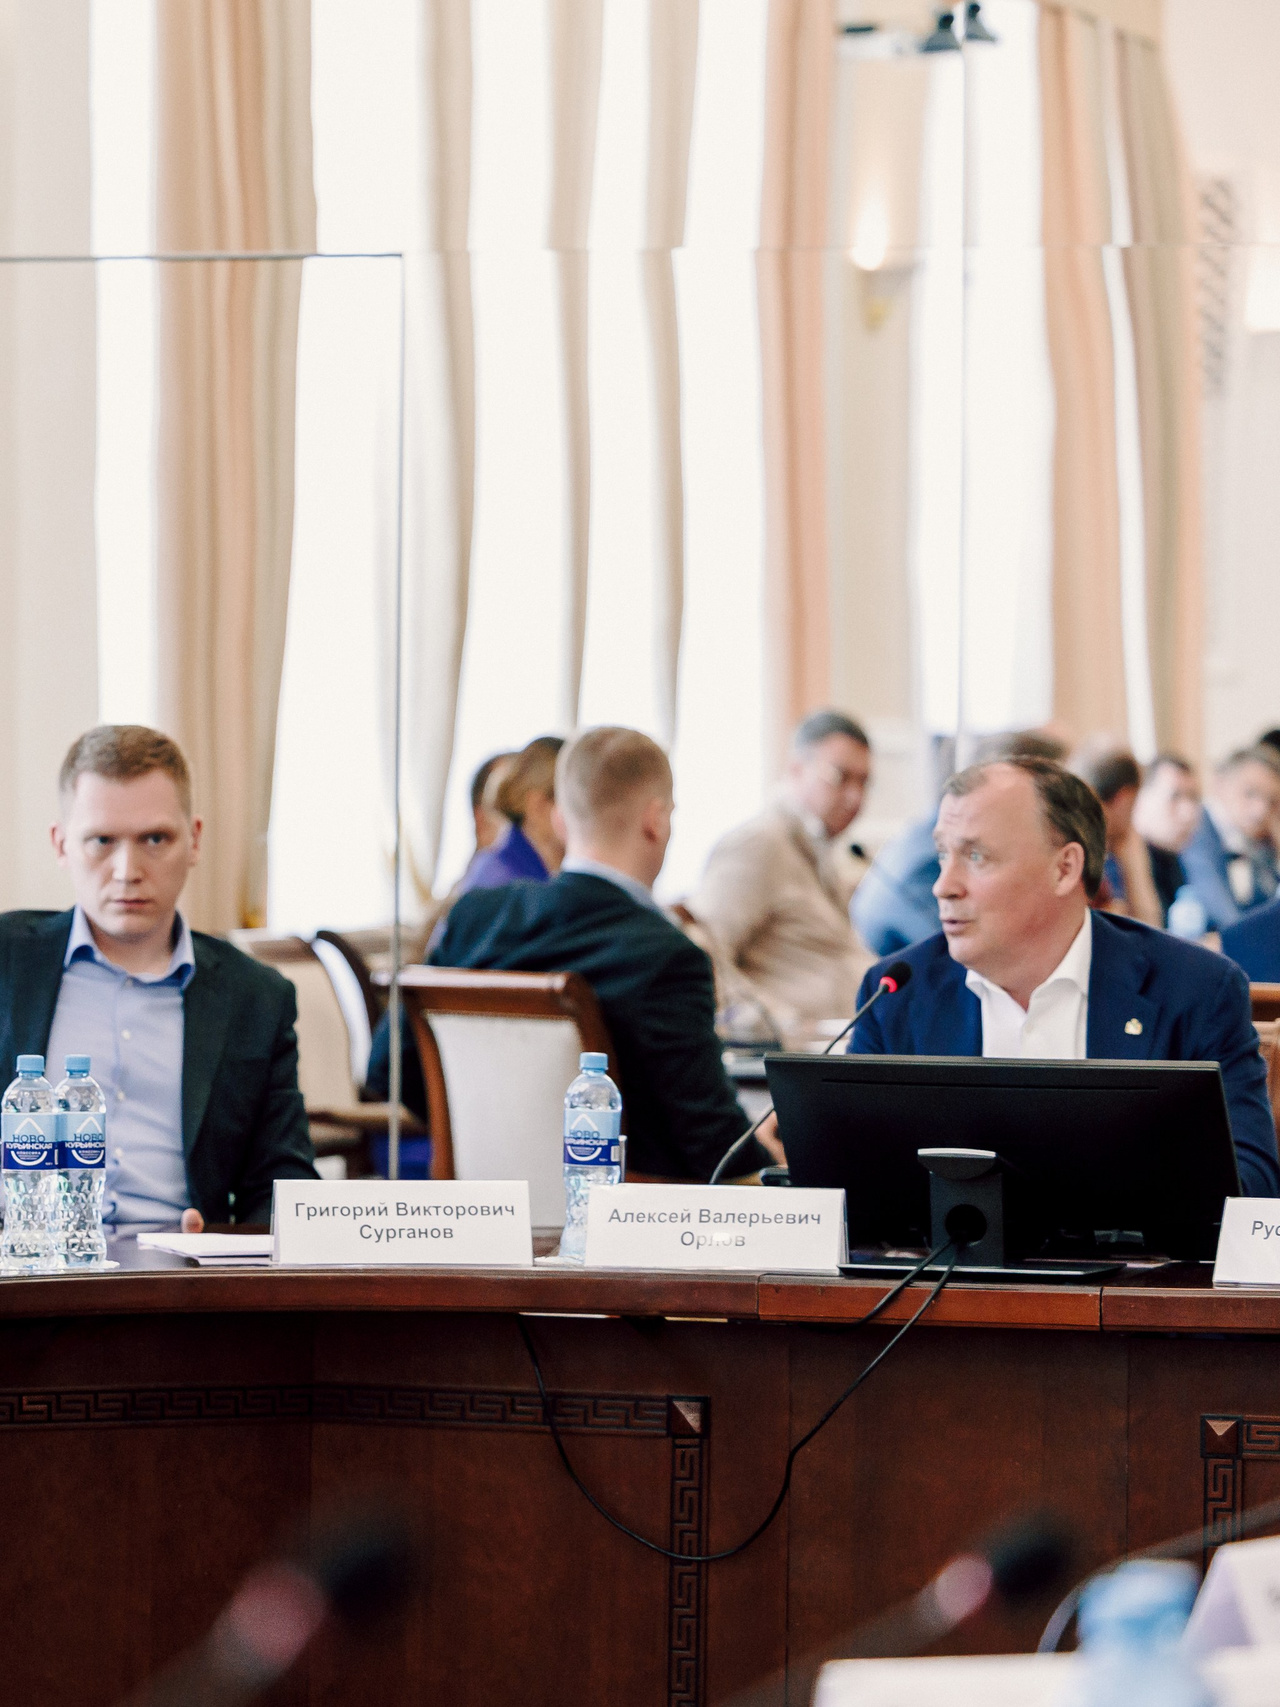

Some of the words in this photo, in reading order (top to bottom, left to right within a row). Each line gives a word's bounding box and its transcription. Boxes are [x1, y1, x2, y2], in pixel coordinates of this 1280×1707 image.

[12, 1134, 46, 1143] НОВО
[295, 1201, 389, 1221] Григорий
[396, 1202, 515, 1218] Викторович
[608, 1208, 691, 1224] Алексей
[698, 1208, 821, 1228] Валерьевич
[359, 1224, 454, 1243] Сурганов
